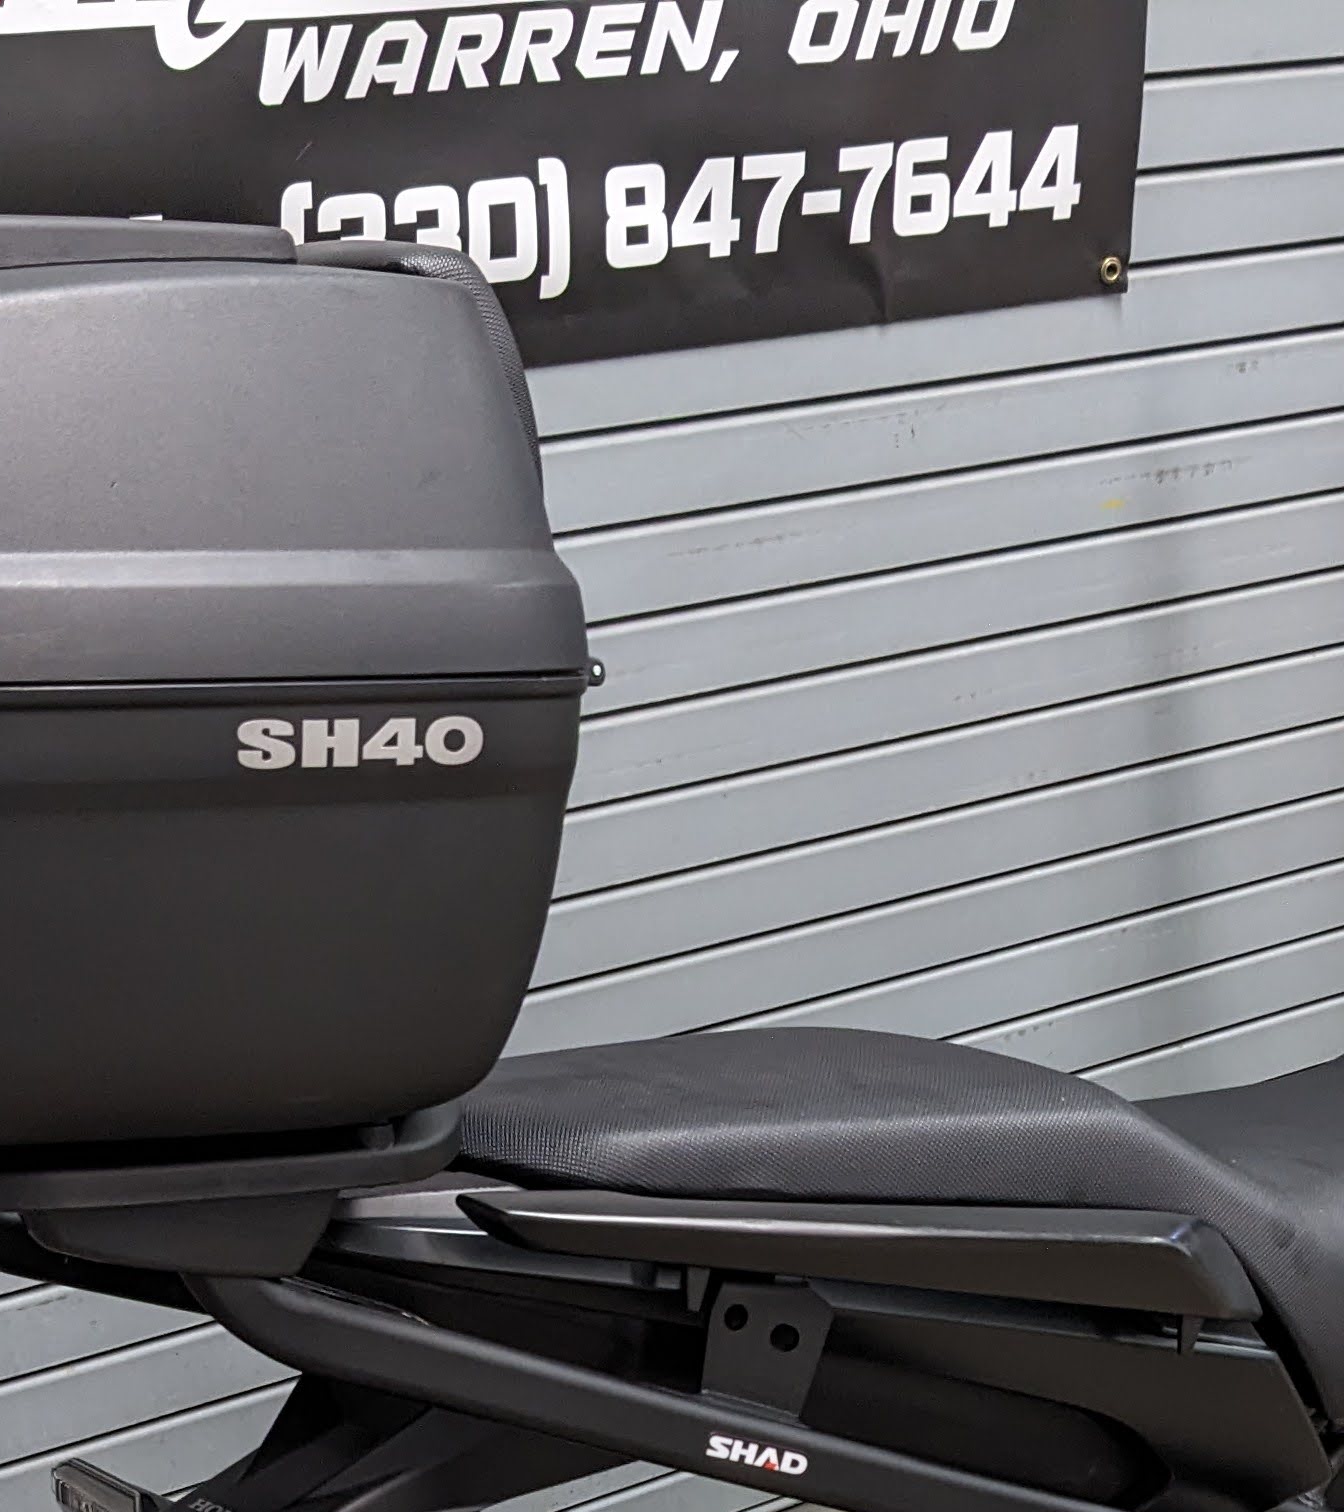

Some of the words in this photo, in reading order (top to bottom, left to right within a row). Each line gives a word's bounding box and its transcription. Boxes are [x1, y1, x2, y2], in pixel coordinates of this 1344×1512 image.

[259, 0, 739, 105] WARREN,
[788, 0, 1015, 64] OHIO
[605, 125, 1081, 268] 847-7644
[237, 715, 484, 769] SH40
[706, 1435, 808, 1475] SHAD
